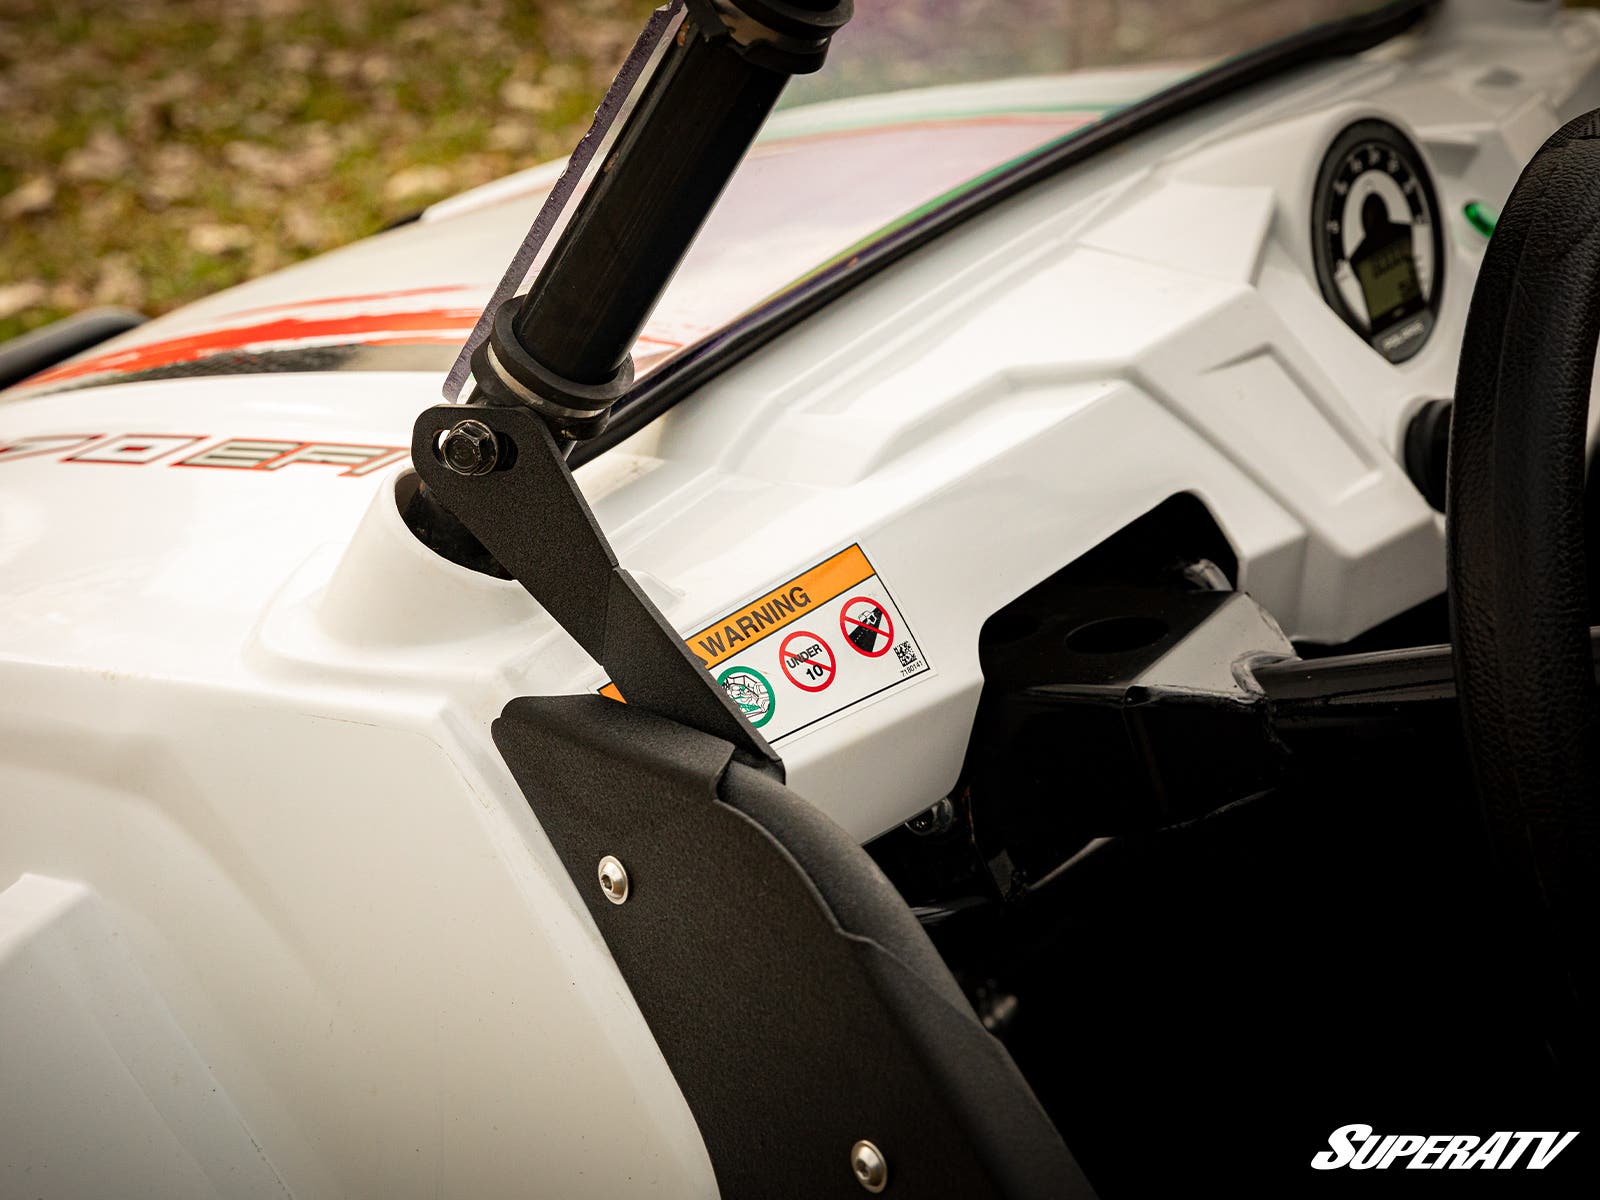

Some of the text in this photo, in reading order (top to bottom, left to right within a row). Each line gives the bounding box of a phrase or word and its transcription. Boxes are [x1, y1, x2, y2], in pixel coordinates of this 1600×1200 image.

[698, 586, 811, 658] WARNING
[786, 643, 823, 670] UNDER
[805, 664, 825, 681] 10
